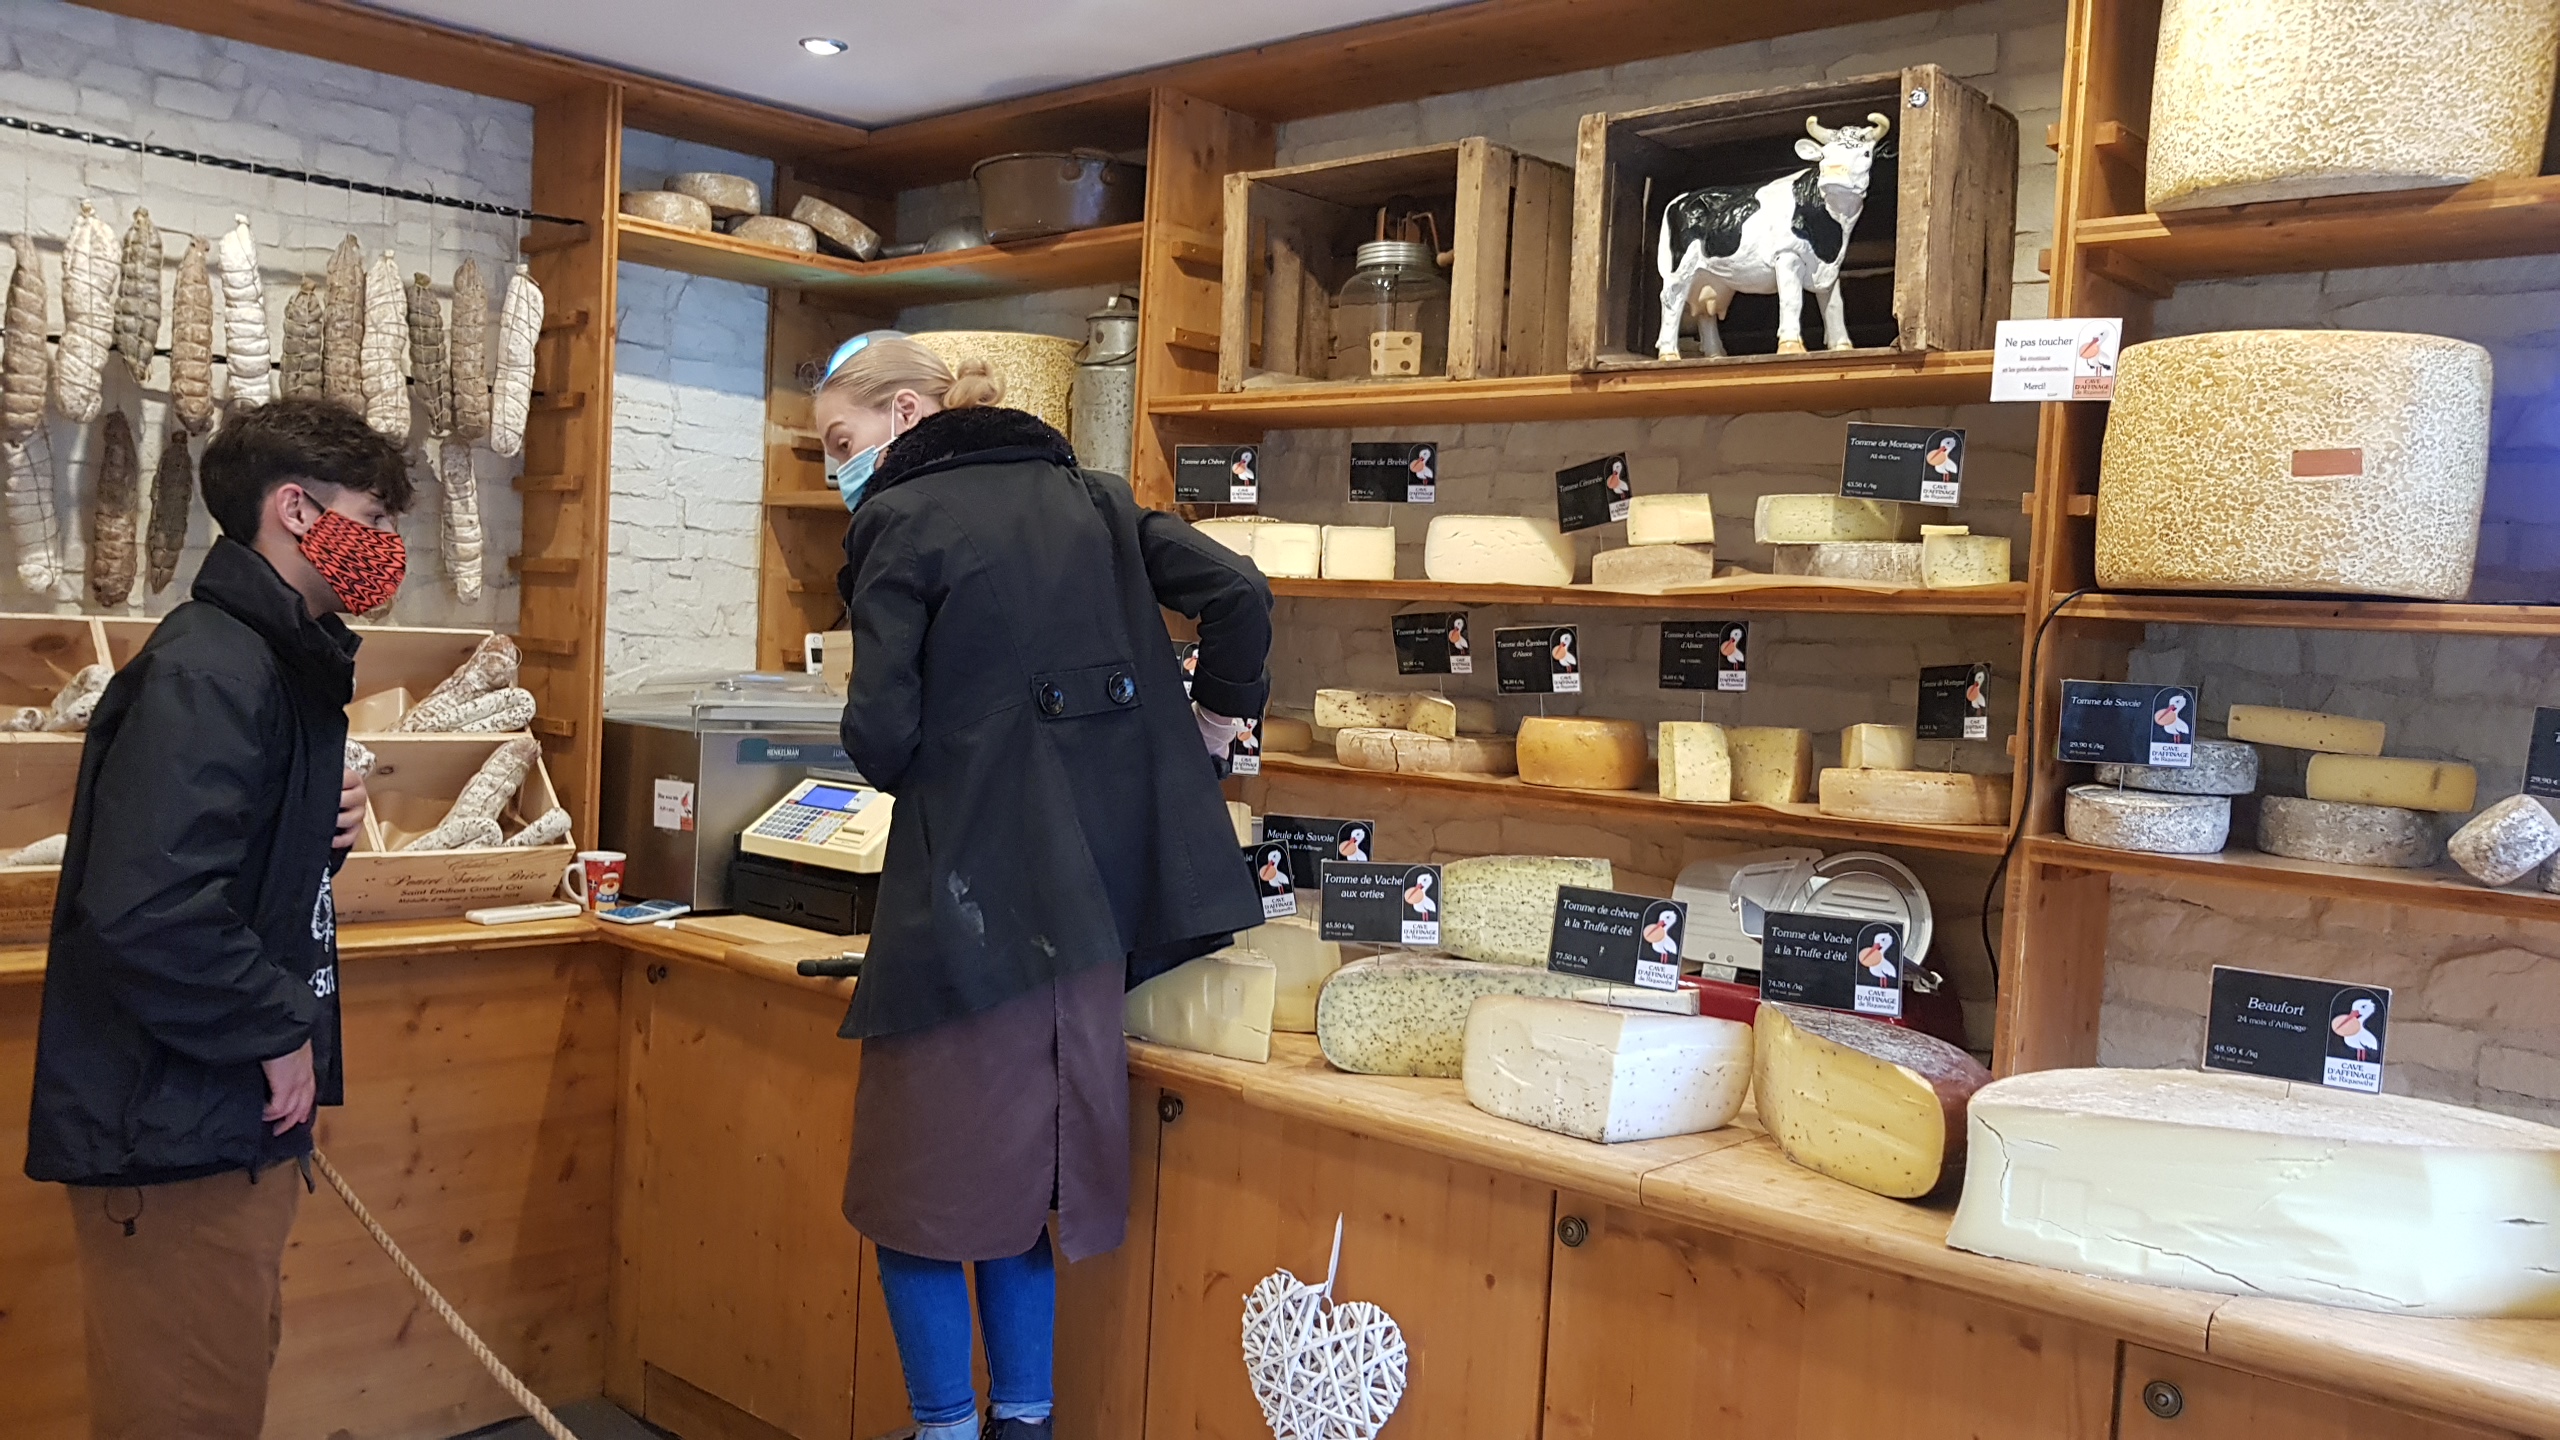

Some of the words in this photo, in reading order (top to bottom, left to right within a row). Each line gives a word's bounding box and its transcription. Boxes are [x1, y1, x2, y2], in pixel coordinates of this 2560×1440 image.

[2005, 337, 2018, 347] Ne
[2020, 340, 2036, 349] pas
[2039, 336, 2073, 346] toucher
[1850, 438, 1877, 446] Tomme
[1878, 439, 1888, 447] de
[1889, 440, 1924, 450] Montagne
[1559, 483, 1579, 492] Tomme
[1680, 641, 1703, 649] d'Alsace
[2071, 696, 2101, 706] Tomme
[2103, 698, 2113, 706] de
[2115, 698, 2142, 708] Savoie
[766, 748, 800, 757] HENKELMAN
[1267, 829, 1292, 840] Meule
[1294, 832, 1304, 840] de
[1306, 832, 1335, 843] Savoie
[1324, 873, 1358, 884] Tomme
[1360, 874, 1372, 885] de
[1374, 875, 1403, 886] Vache
[401, 889, 426, 897] Saint
[470, 885, 502, 893] Grand
[1341, 890, 1358, 898] aux
[1359, 890, 1385, 899] orties
[1563, 899, 1596, 913] Tomme
[1597, 905, 1608, 915] de
[1610, 908, 1639, 920] chèvre
[1564, 917, 1570, 927] à
[1572, 918, 1580, 928] la
[1583, 920, 1608, 932] Truffe
[1610, 923, 1633, 937] d'été
[1771, 926, 1806, 939] Tomme
[1808, 931, 1820, 941] de
[1823, 932, 1853, 945] Vache
[1774, 945, 1780, 954] à
[1783, 945, 1791, 955] la
[1795, 946, 1822, 959] Truffe
[1824, 950, 1848, 962] d'été
[1638, 969, 1675, 980] D'AFFINAGE
[1857, 995, 1897, 1004] D'AFFINAGE
[2247, 996, 2305, 1016] Beaufort
[2237, 1015, 2248, 1023] 24
[2249, 1017, 2267, 1027] mois
[2269, 1019, 2307, 1032] d'Affinage
[2341, 1062, 2364, 1072] CAVE
[2327, 1068, 2376, 1081] D'AFFINAGE
